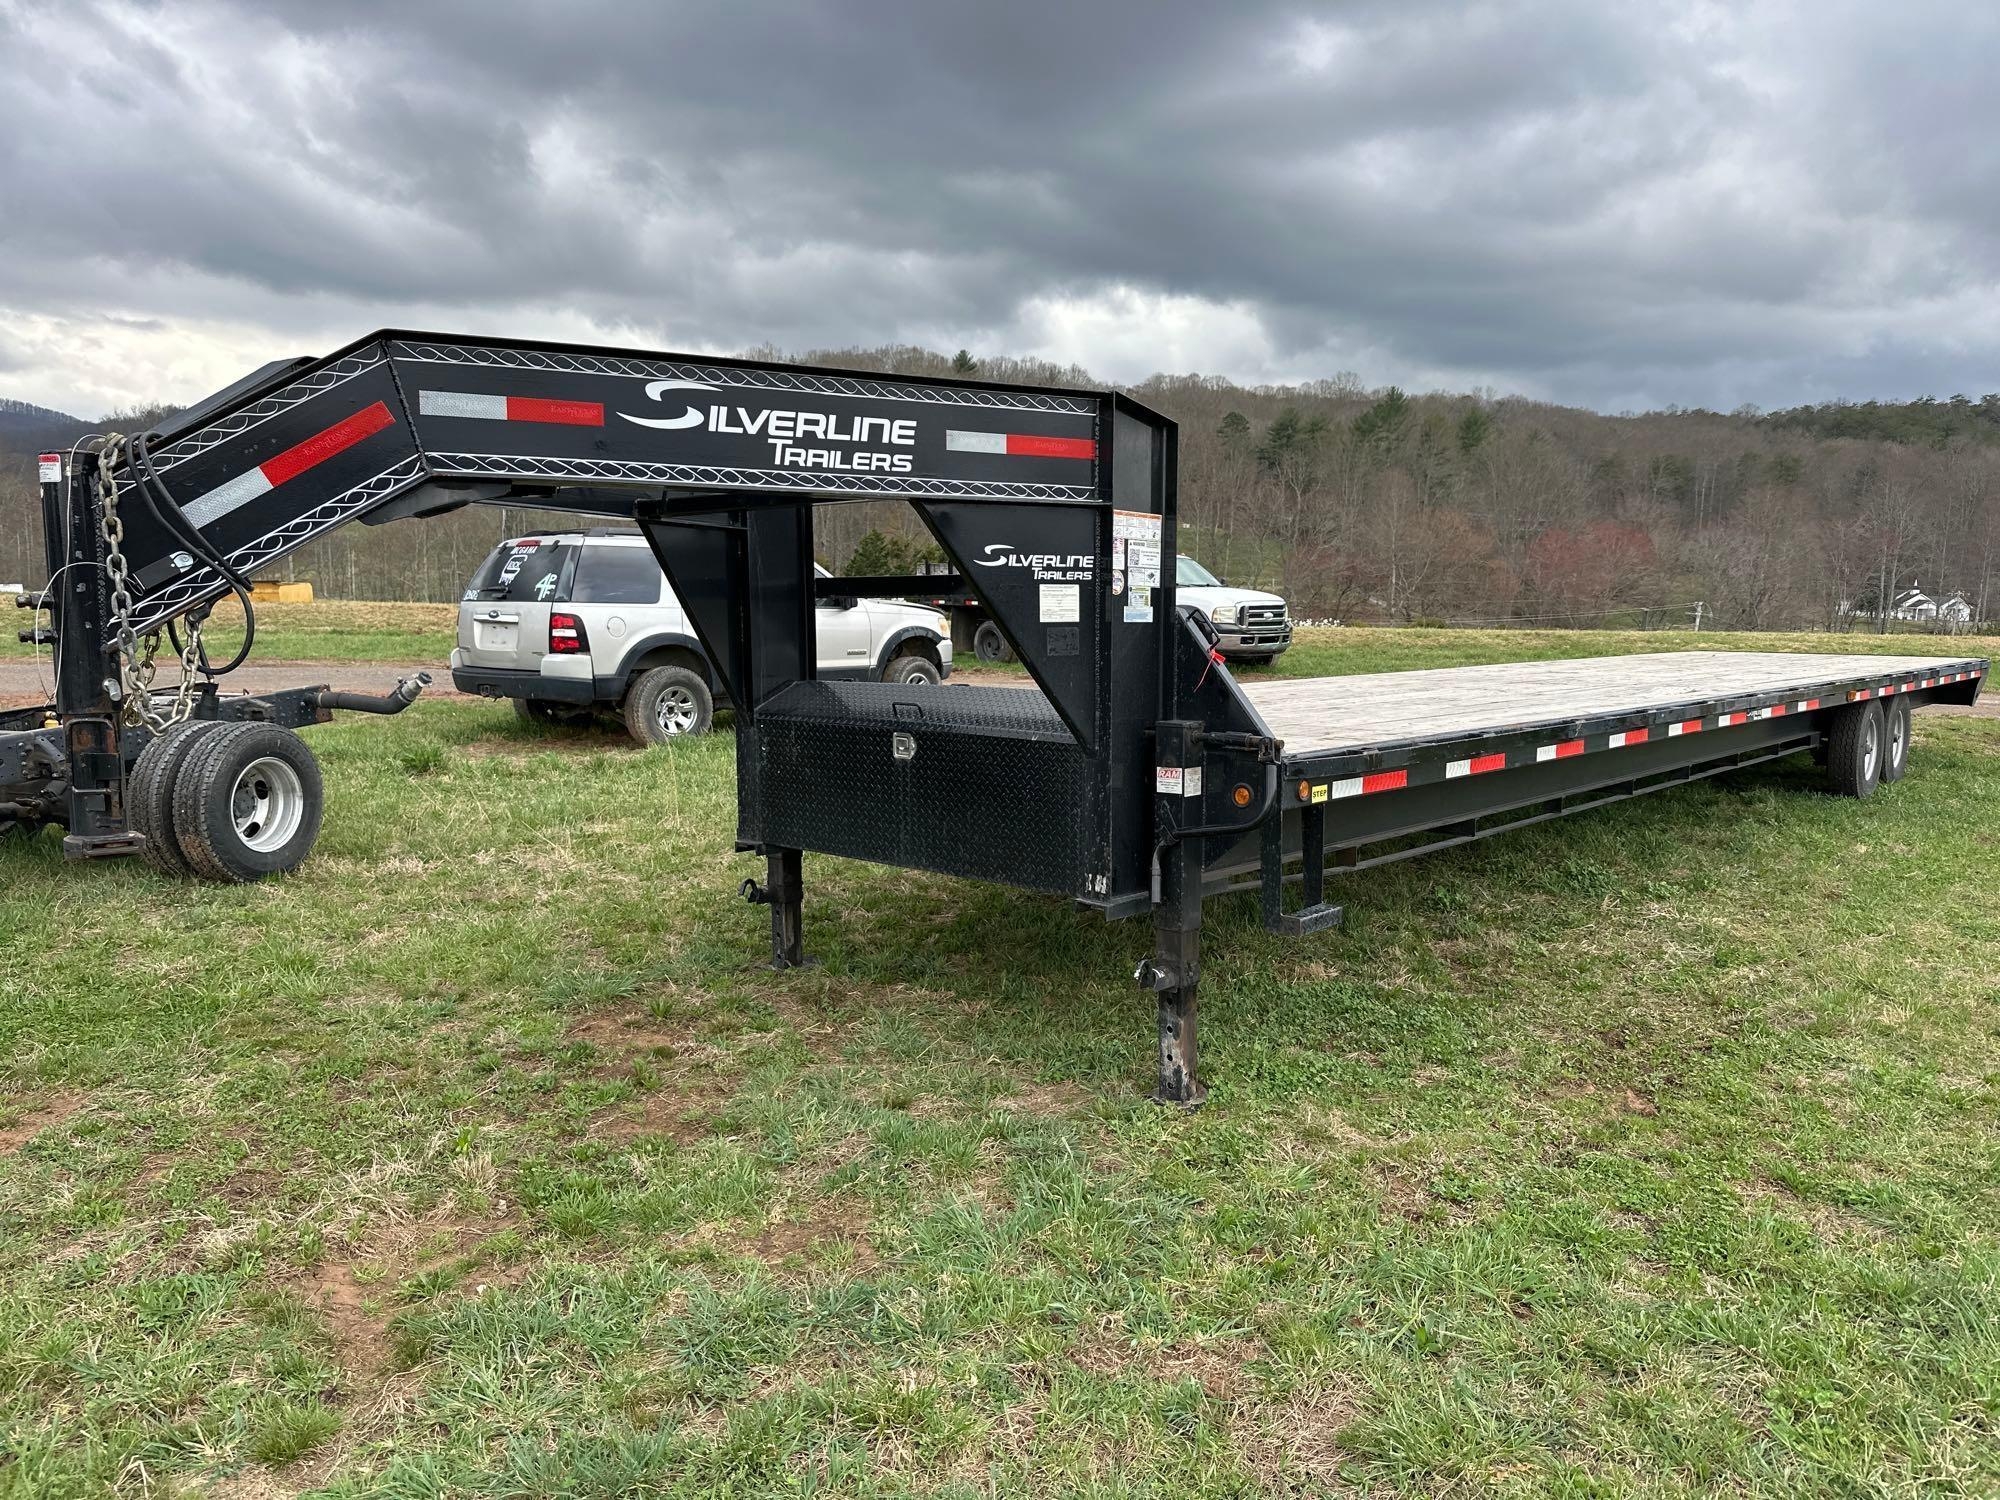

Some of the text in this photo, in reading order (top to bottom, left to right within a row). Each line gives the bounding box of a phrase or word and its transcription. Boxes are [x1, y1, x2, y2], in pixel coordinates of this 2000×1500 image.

[616, 380, 917, 446] SILVERLINE
[767, 438, 913, 472] TRAILERS
[973, 544, 1095, 568] SILVERLINE
[1031, 567, 1093, 581] TRAILERS
[1158, 768, 1181, 779] RAM
[1312, 788, 1327, 799] STEP
